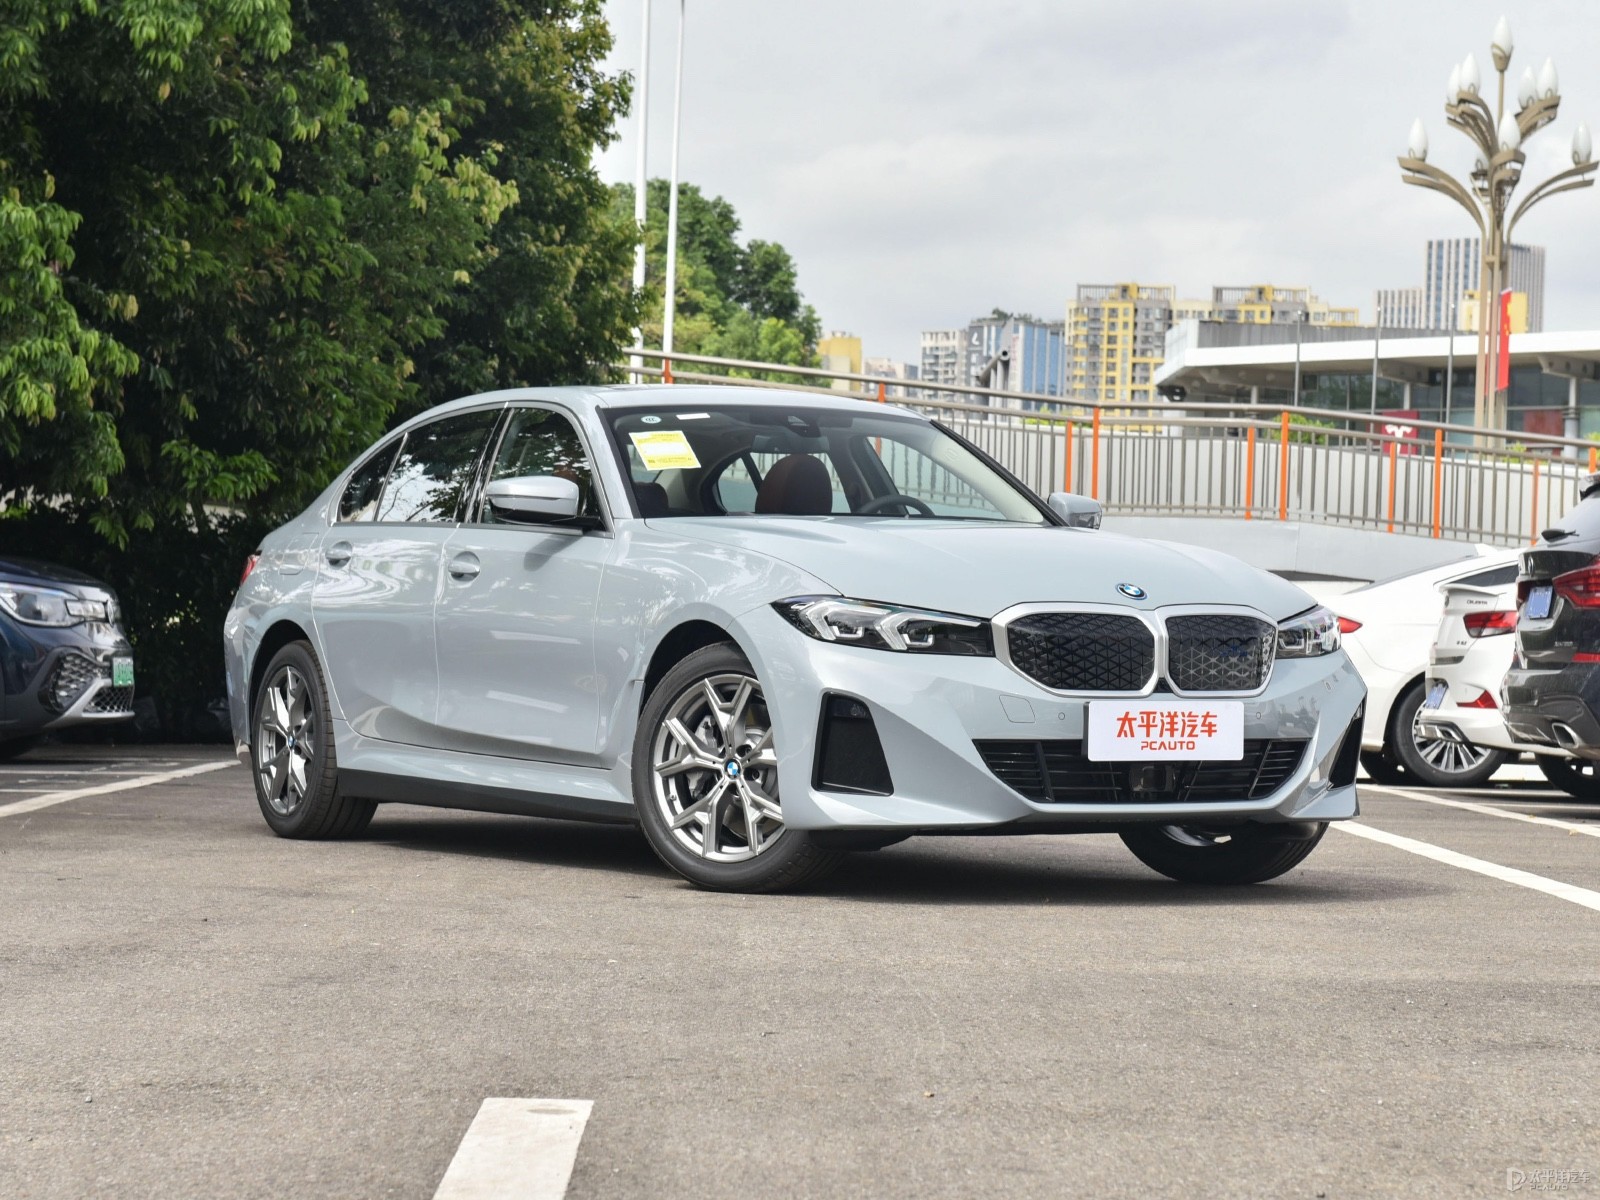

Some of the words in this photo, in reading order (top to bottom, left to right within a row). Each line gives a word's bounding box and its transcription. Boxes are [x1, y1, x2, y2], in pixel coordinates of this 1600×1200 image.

[1116, 711, 1218, 738] 太平洋汽车
[1140, 741, 1196, 751] PCAUTO
